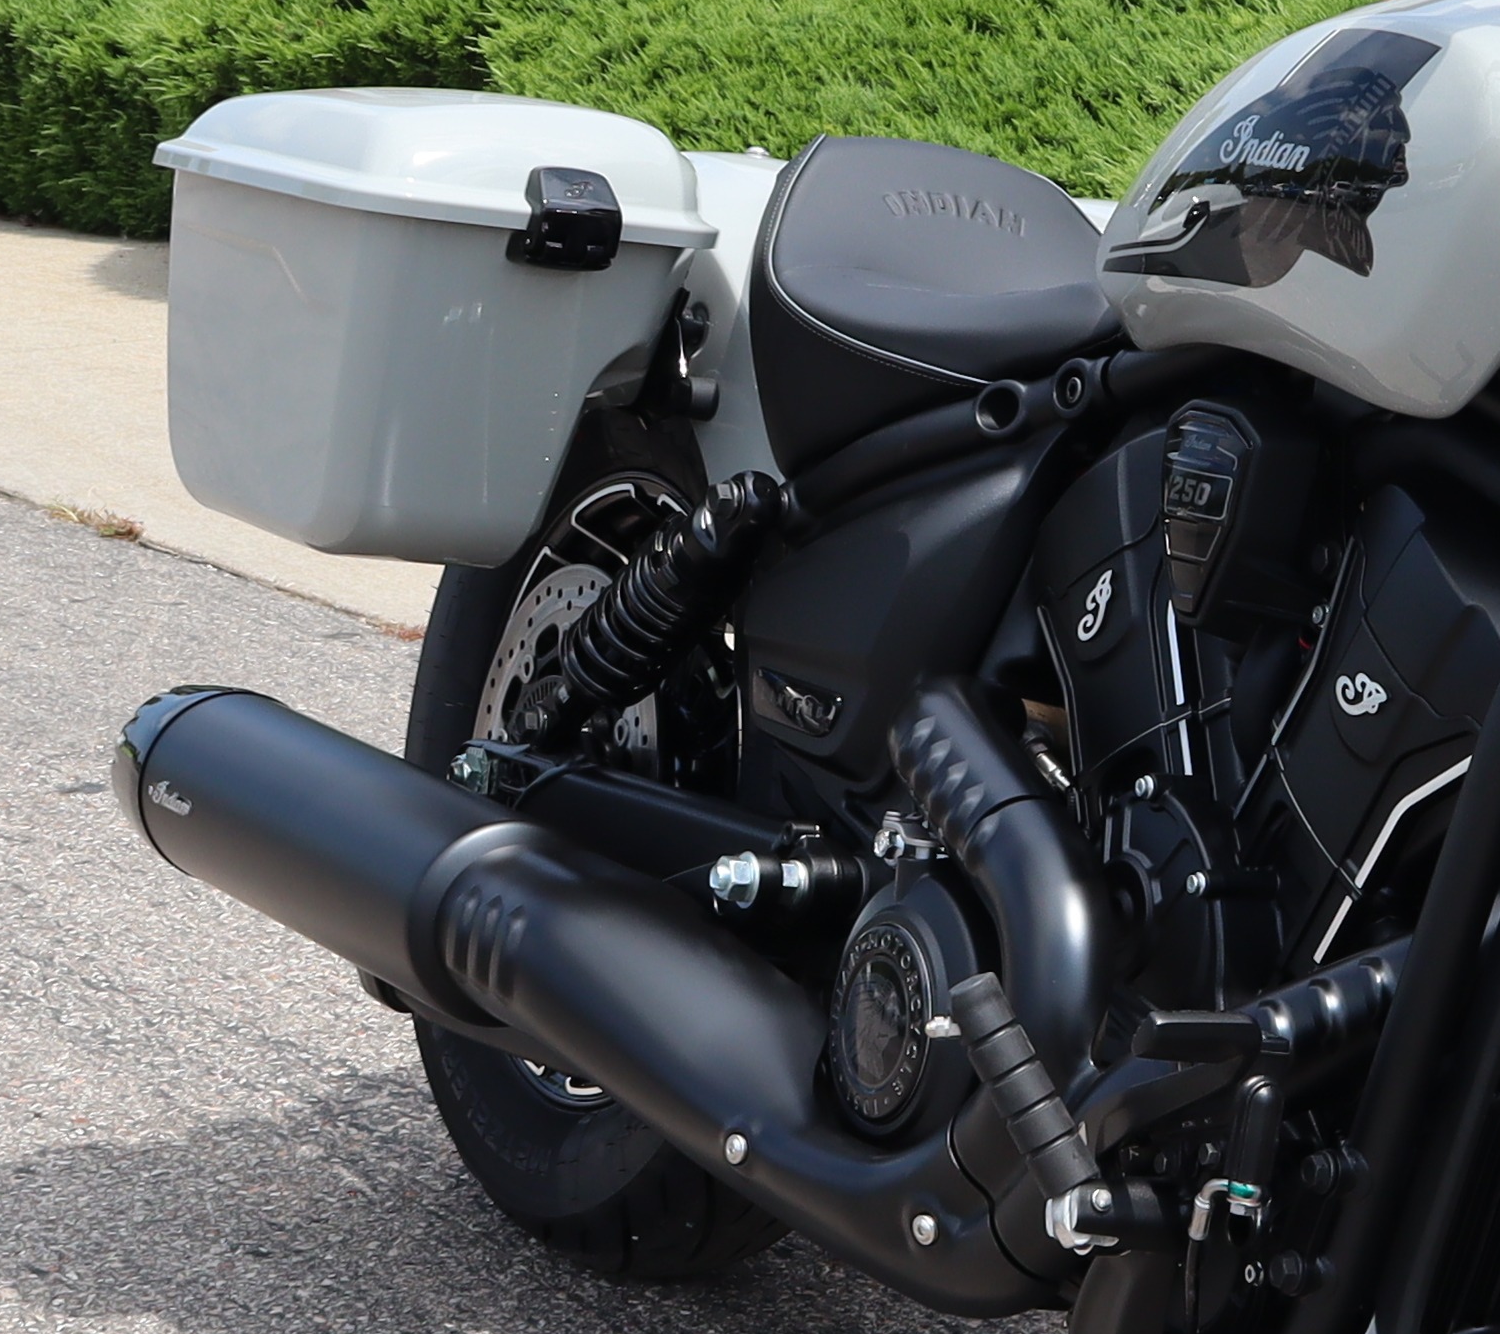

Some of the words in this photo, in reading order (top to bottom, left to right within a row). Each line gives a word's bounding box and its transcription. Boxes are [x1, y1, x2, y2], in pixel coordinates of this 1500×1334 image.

[1220, 115, 1311, 173] Indian
[882, 190, 1025, 236] INDIAN
[1169, 475, 1212, 506] 250
